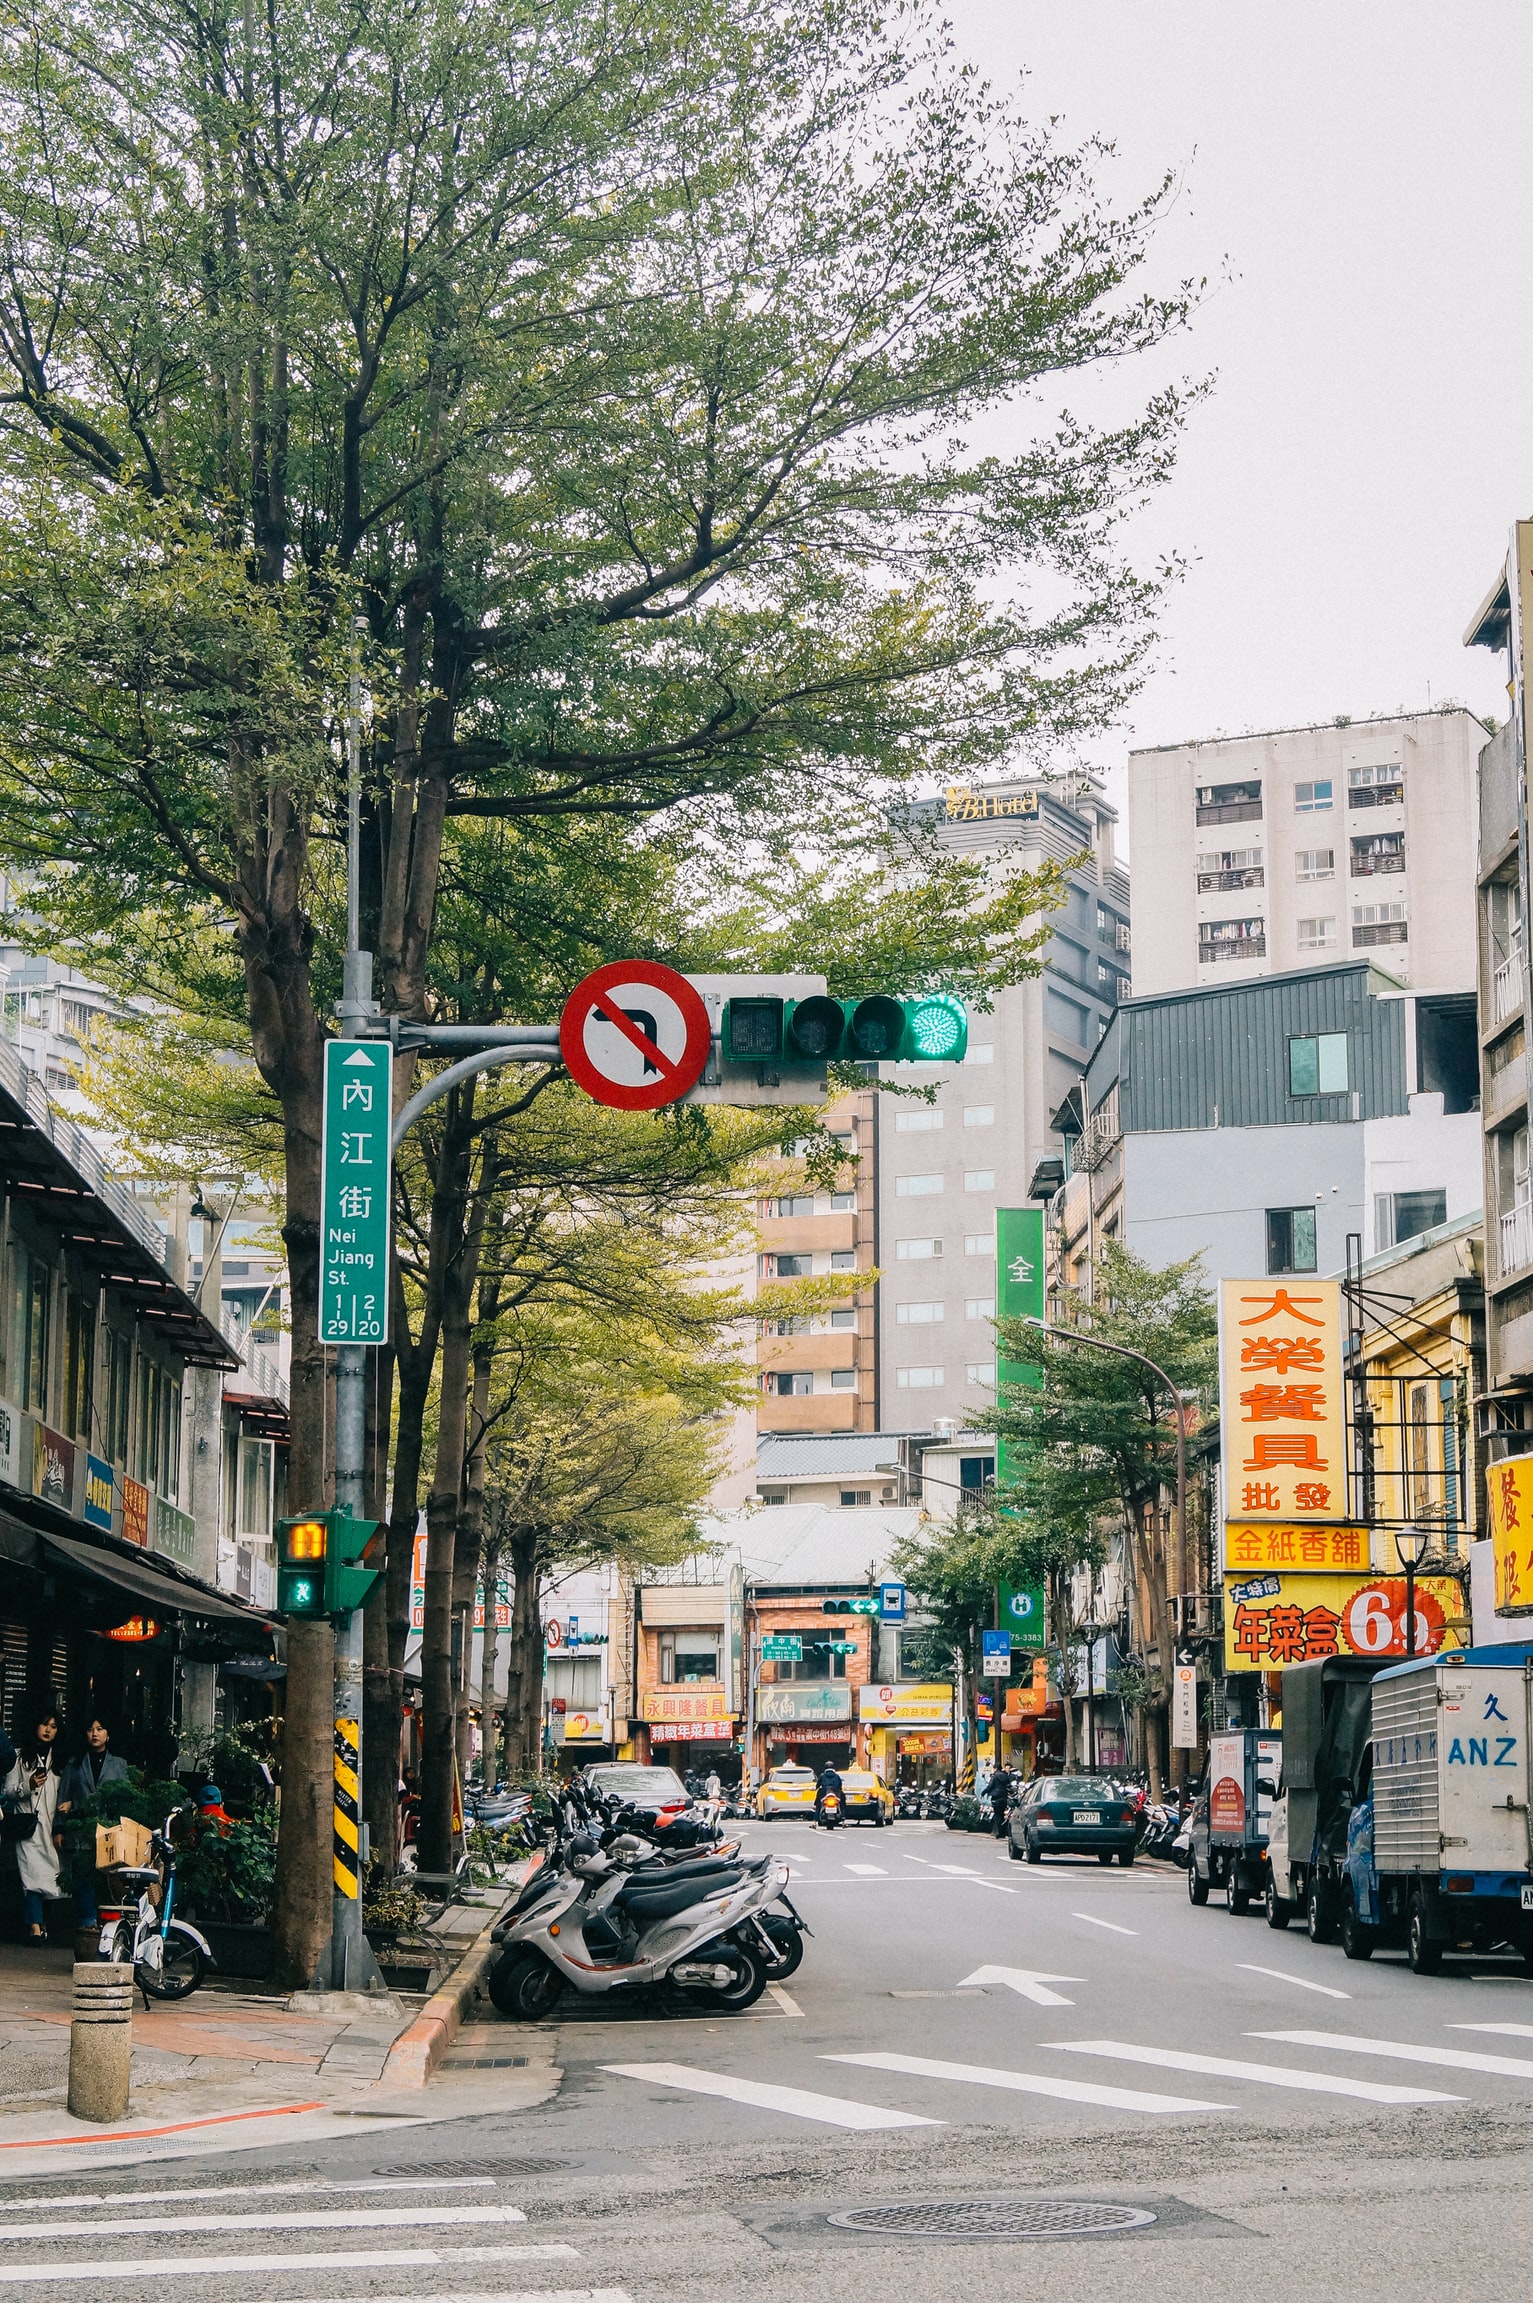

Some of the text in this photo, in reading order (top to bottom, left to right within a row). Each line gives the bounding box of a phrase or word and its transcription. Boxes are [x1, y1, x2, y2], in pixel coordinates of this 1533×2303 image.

[339, 1078, 373, 1219] 內江街
[329, 1228, 356, 1243] Nei
[328, 1249, 374, 1270] Jiang
[328, 1270, 350, 1285] St.
[327, 1320, 380, 1336] 29 20
[1238, 1288, 1329, 1472] 大榮餐具
[1241, 1481, 1331, 1511] 批發
[294, 1523, 323, 1559] 17
[1232, 1603, 1341, 1663] 年菜盒
[1447, 1737, 1518, 1767] ANZ
